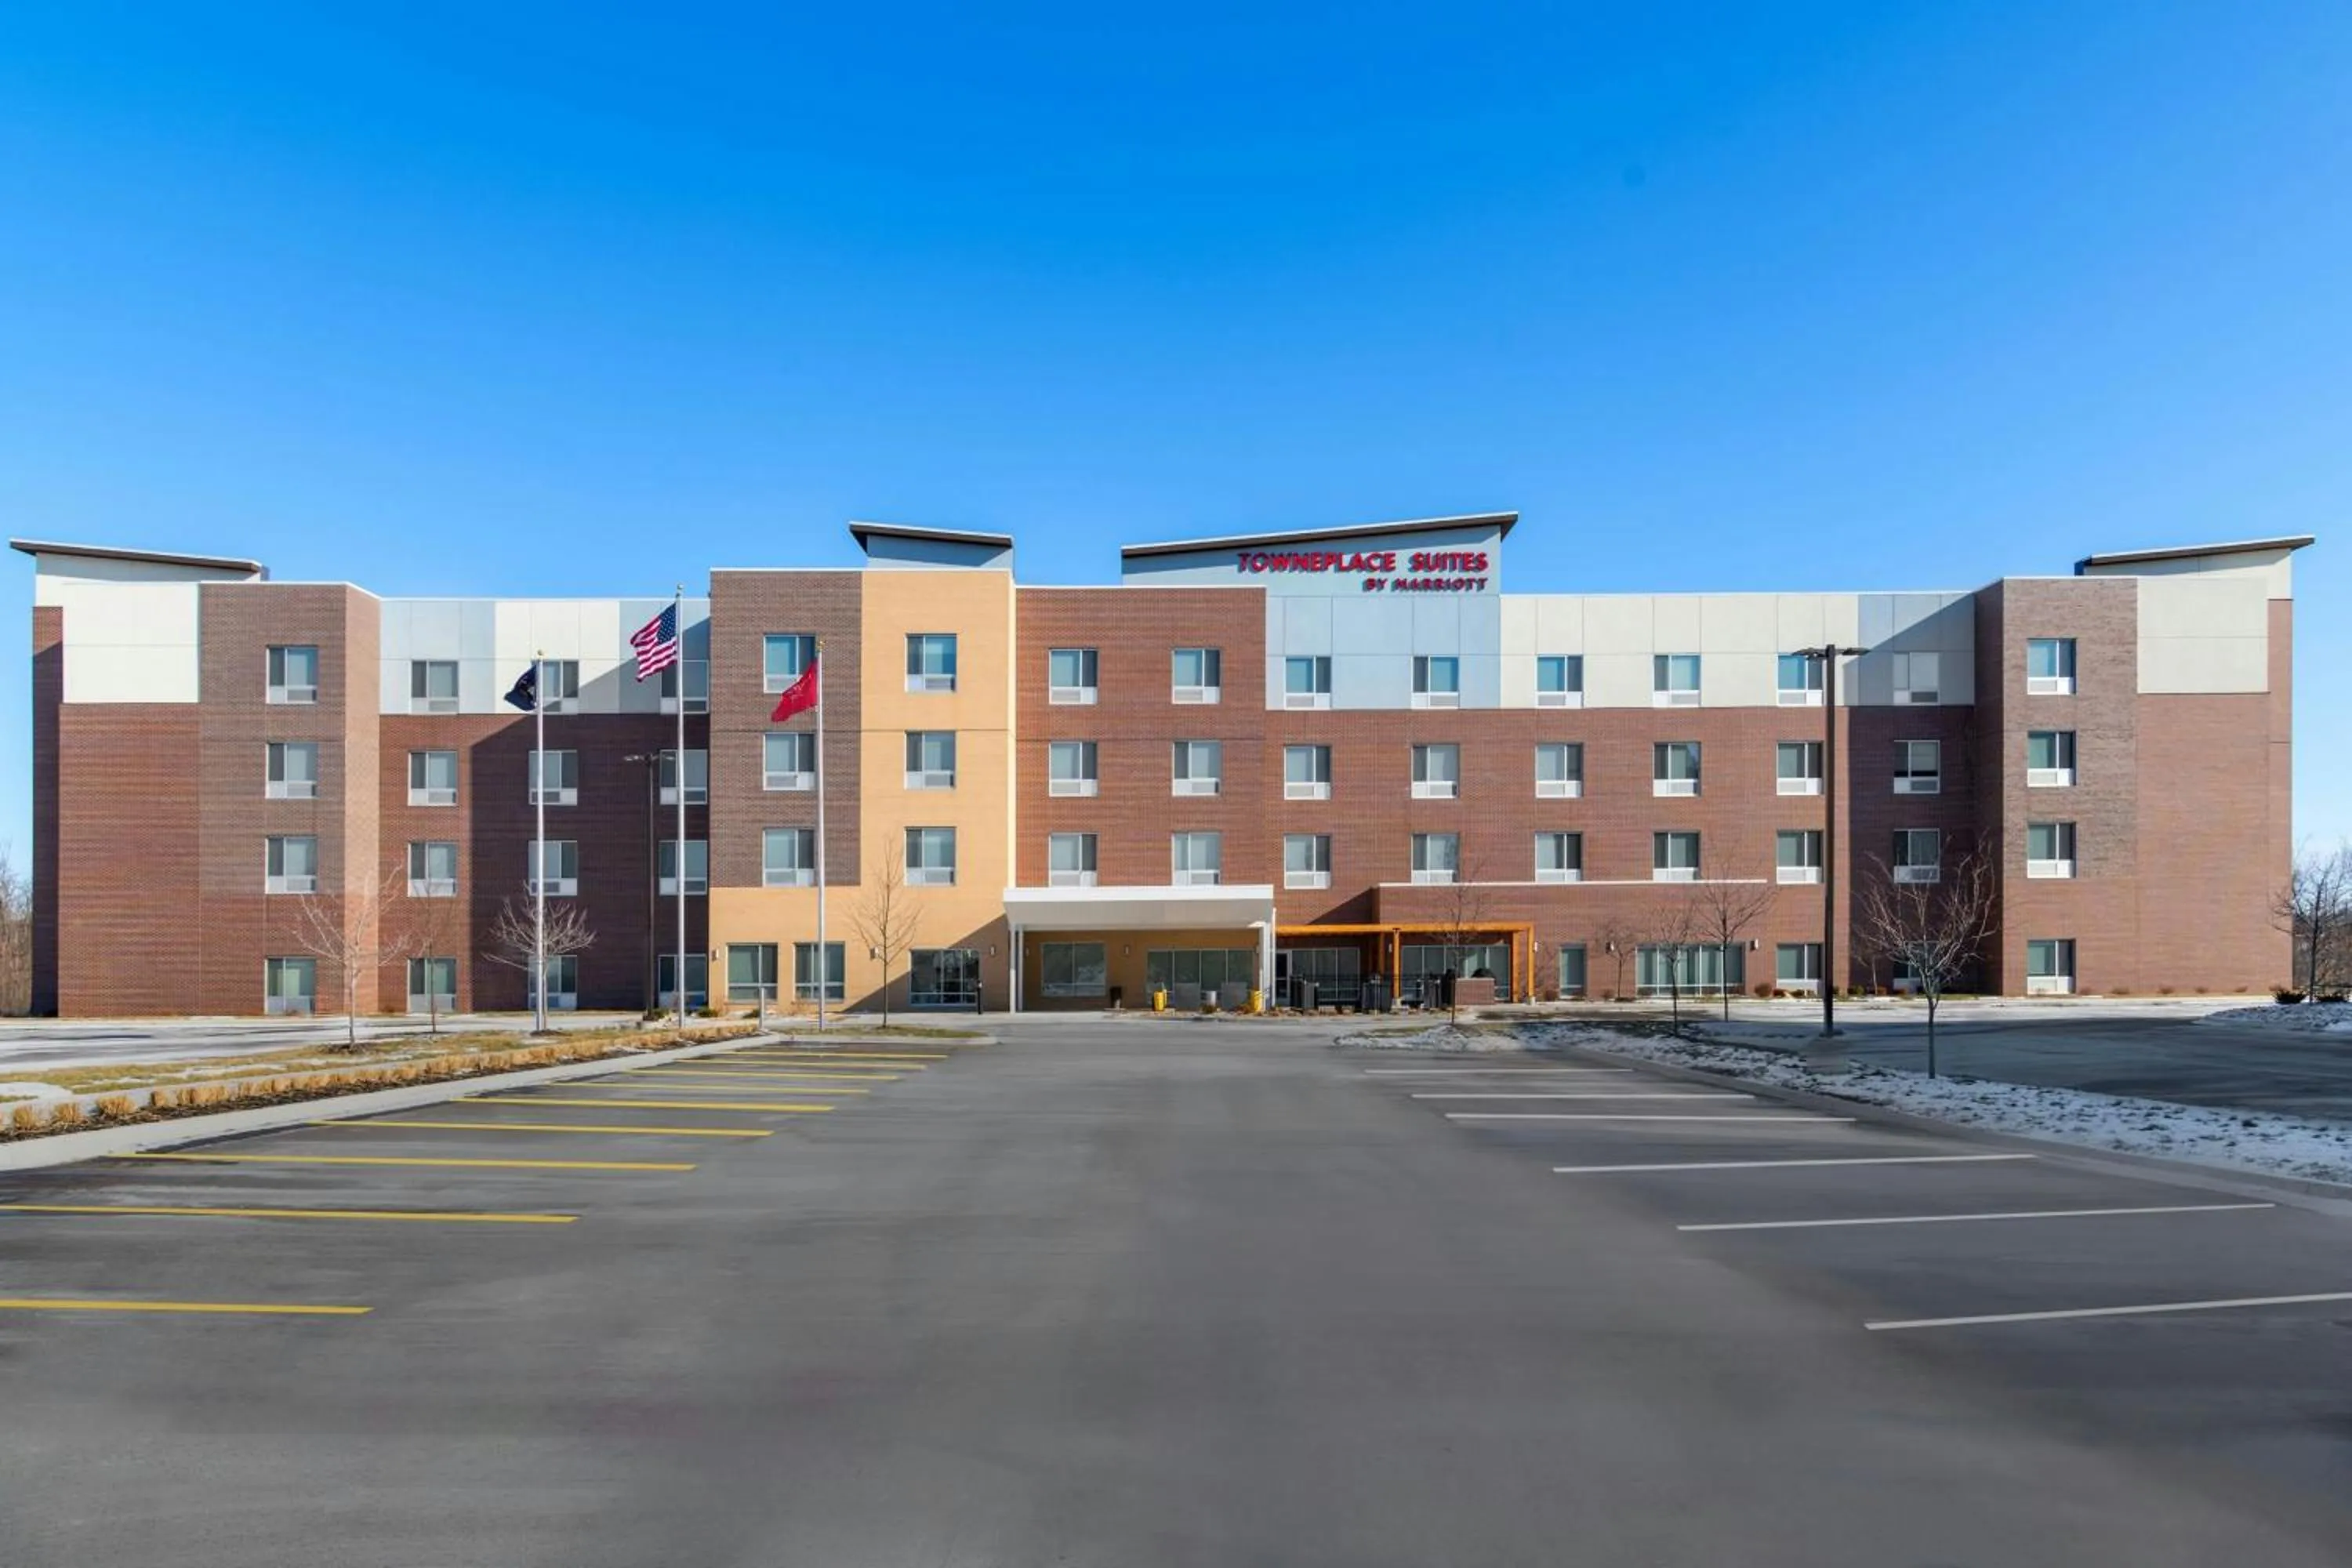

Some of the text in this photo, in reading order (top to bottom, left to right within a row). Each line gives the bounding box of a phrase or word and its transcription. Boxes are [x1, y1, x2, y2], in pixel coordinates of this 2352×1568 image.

[1238, 551, 1488, 572] TOWNEPLACE SUITES
[1364, 577, 1488, 591] BY MARRIOTT
